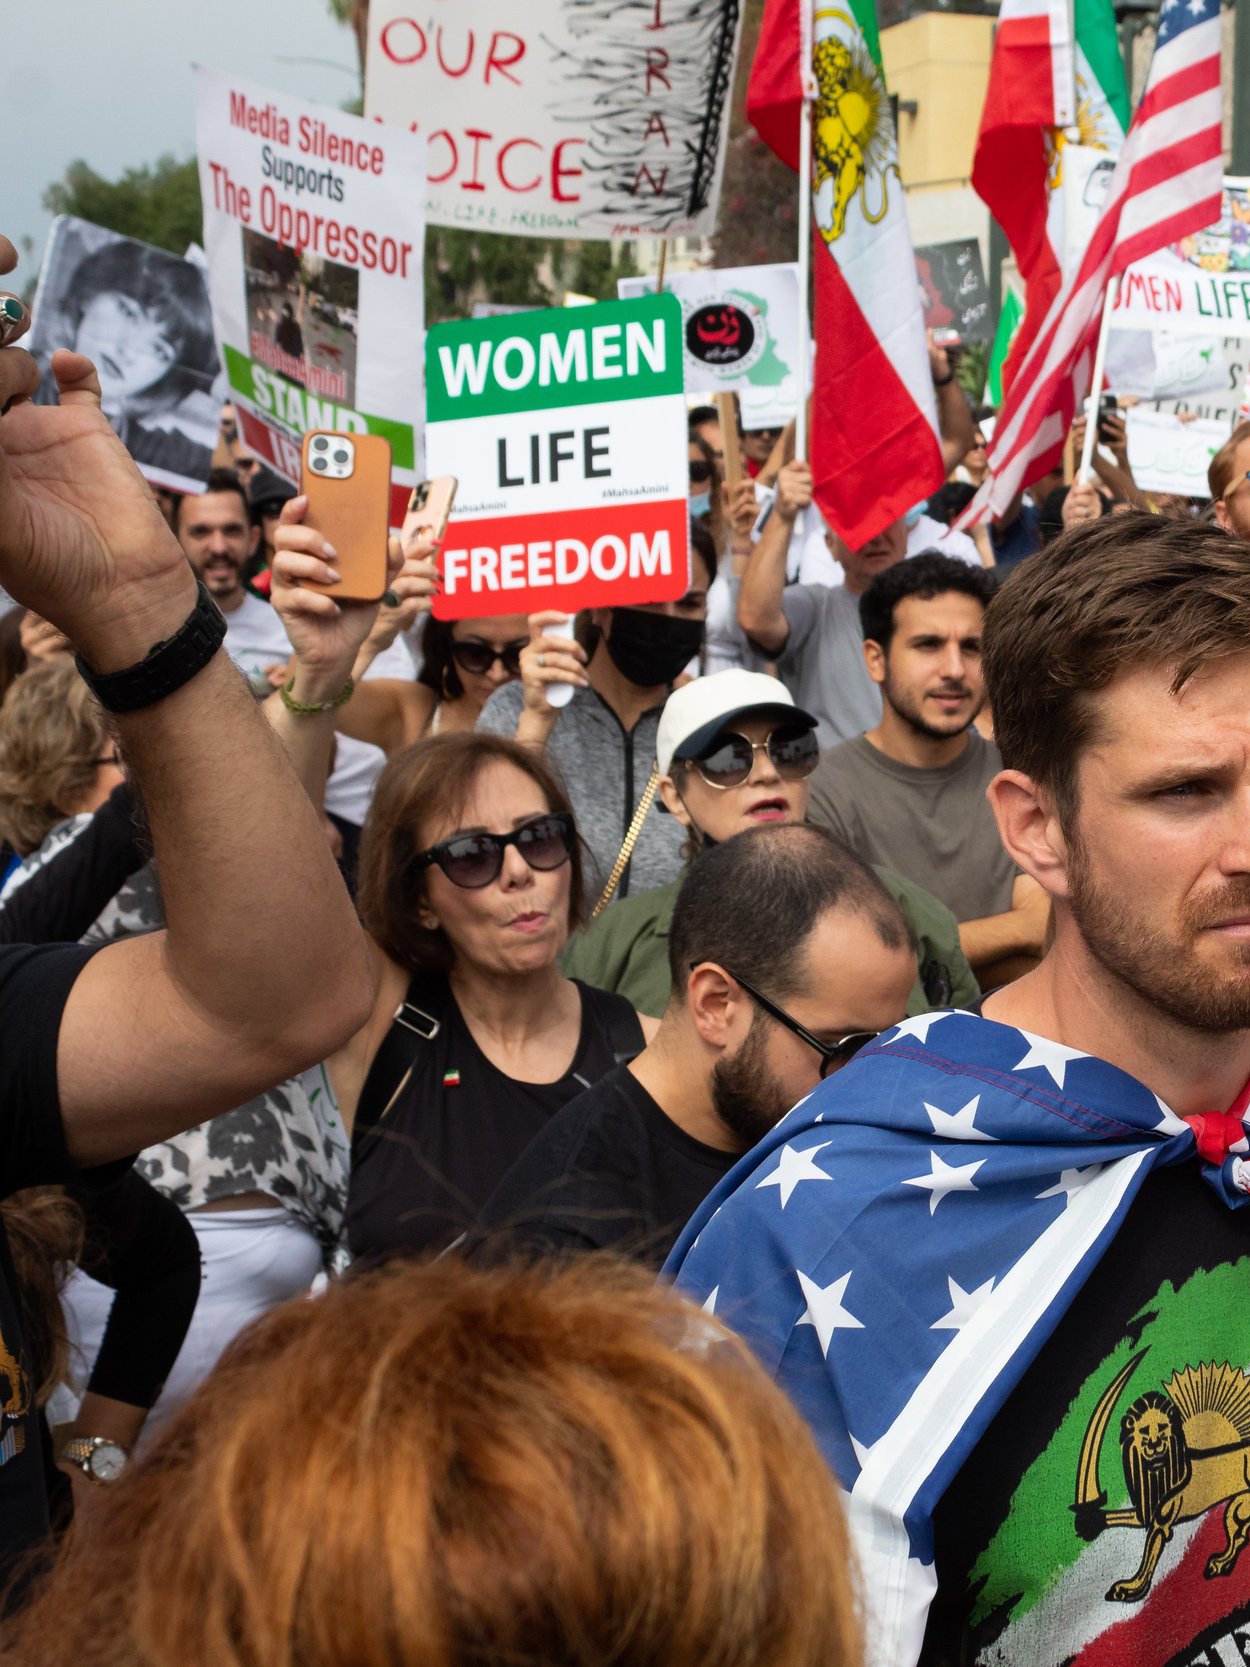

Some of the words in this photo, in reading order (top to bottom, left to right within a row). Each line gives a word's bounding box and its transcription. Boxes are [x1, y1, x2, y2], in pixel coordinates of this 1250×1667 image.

[380, 17, 527, 87] OUR
[229, 90, 291, 146] Media
[298, 114, 385, 176] Silence
[406, 121, 588, 204] OICE
[261, 145, 345, 203] Supports
[208, 160, 252, 224] The
[260, 184, 413, 279] Oppressor
[437, 318, 667, 398] WOMEN
[497, 425, 612, 488] LIFE
[449, 500, 508, 514] MahsaAmini
[443, 529, 673, 595] FREEDOM
